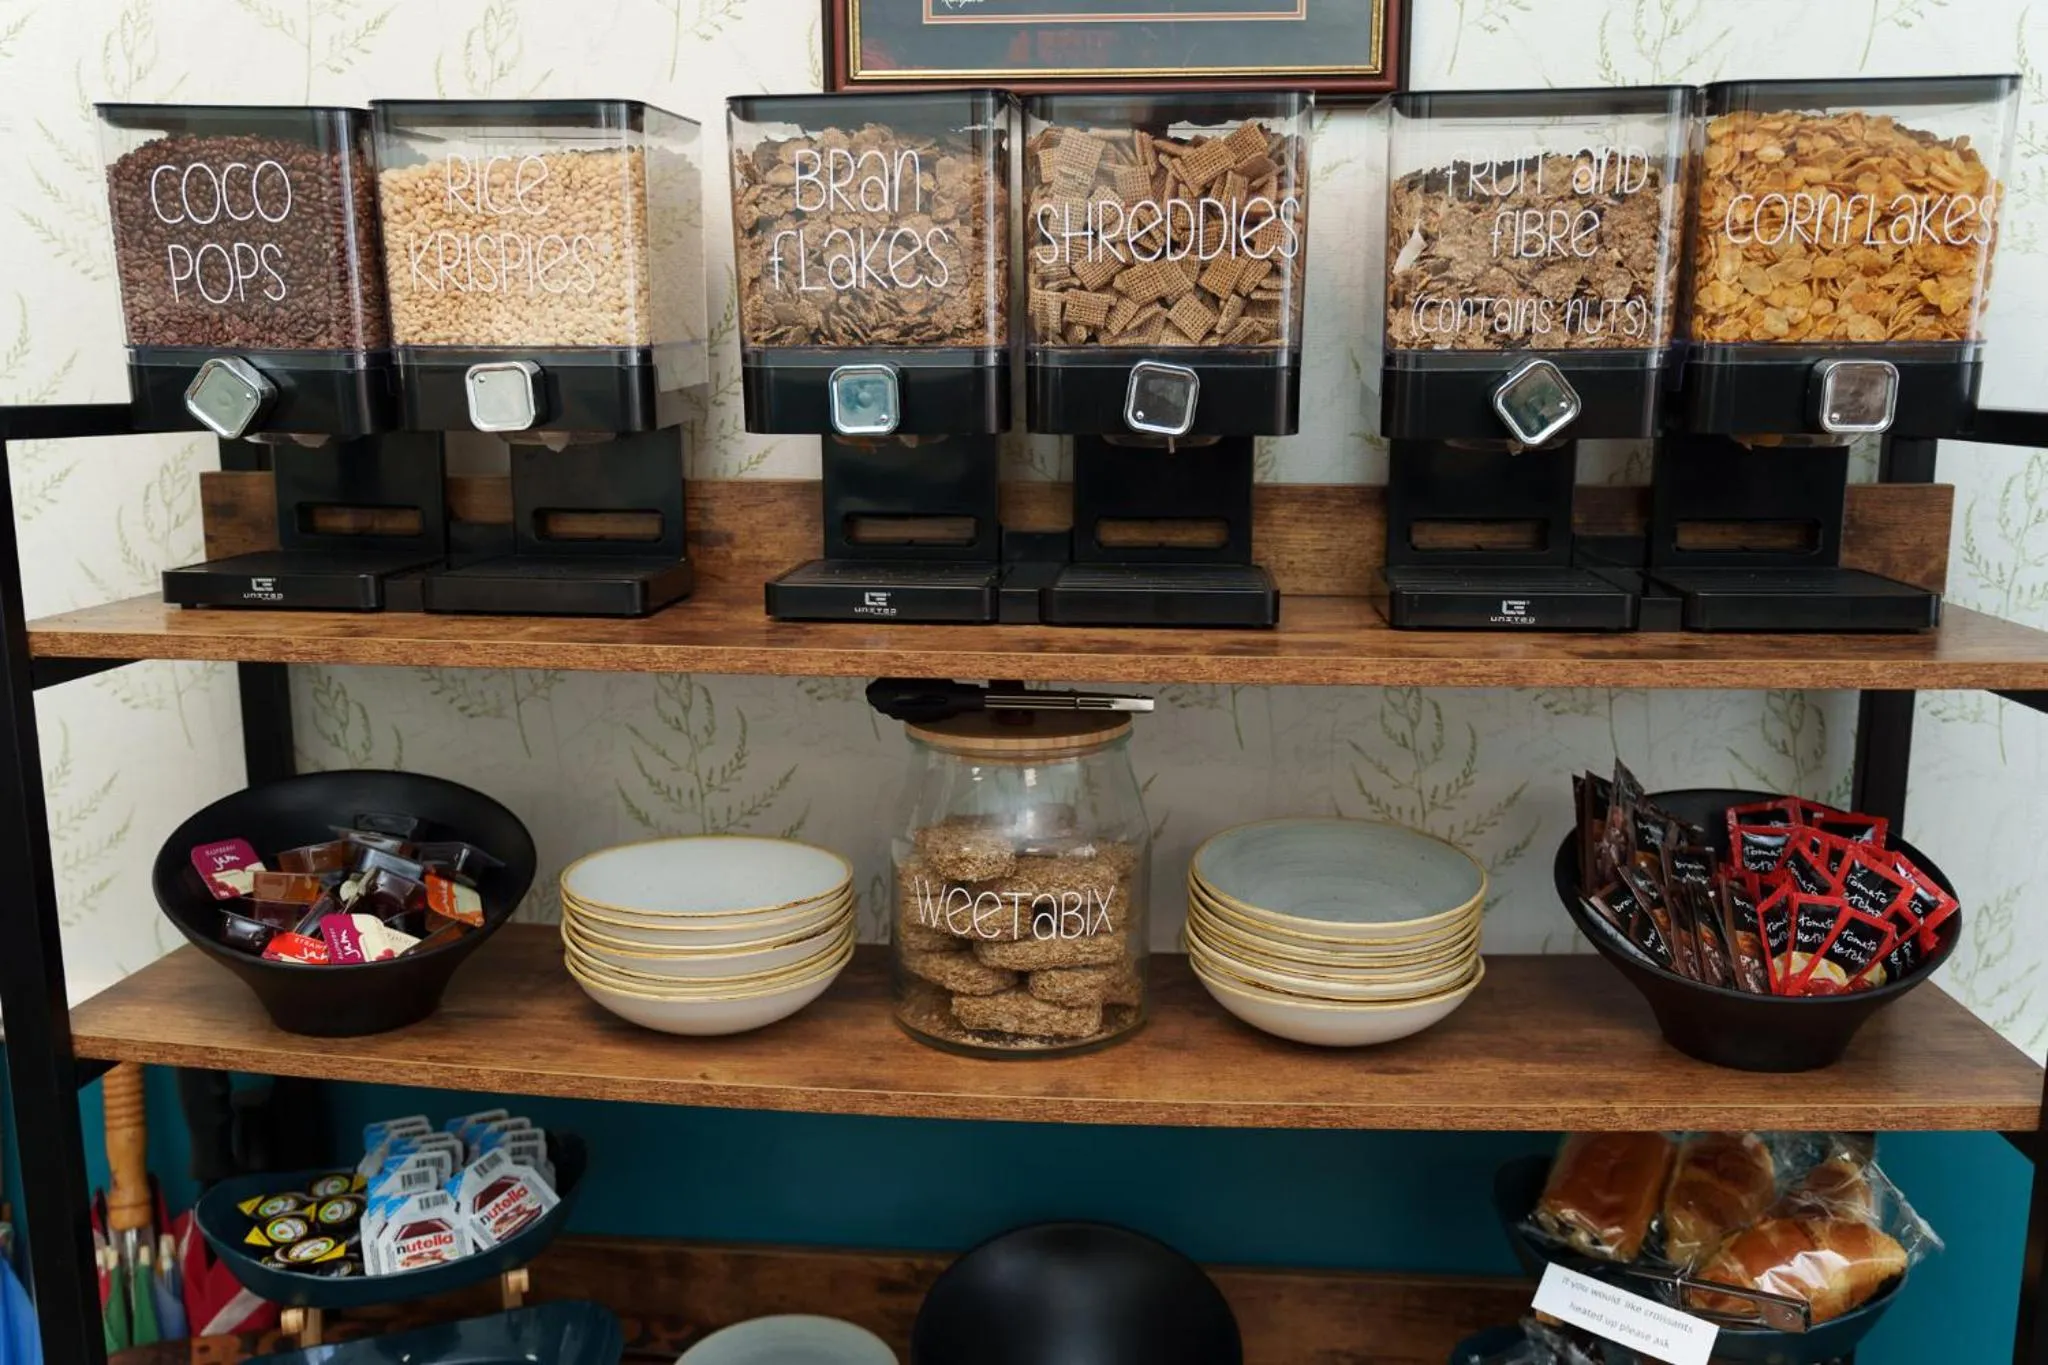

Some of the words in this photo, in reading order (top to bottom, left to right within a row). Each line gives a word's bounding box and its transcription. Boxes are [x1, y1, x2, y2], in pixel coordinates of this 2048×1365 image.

[151, 160, 292, 225] COCO
[167, 241, 287, 304] POPS
[479, 1184, 529, 1226] nutella
[396, 1233, 454, 1255] nutella
[1568, 1300, 1605, 1323] heated
[1618, 1322, 1652, 1342] please
[1652, 1335, 1671, 1350] ask
[1570, 1280, 1589, 1293] you
[1590, 1288, 1621, 1306] would
[1623, 1298, 1642, 1313] like
[1643, 1307, 1693, 1334] croissants
